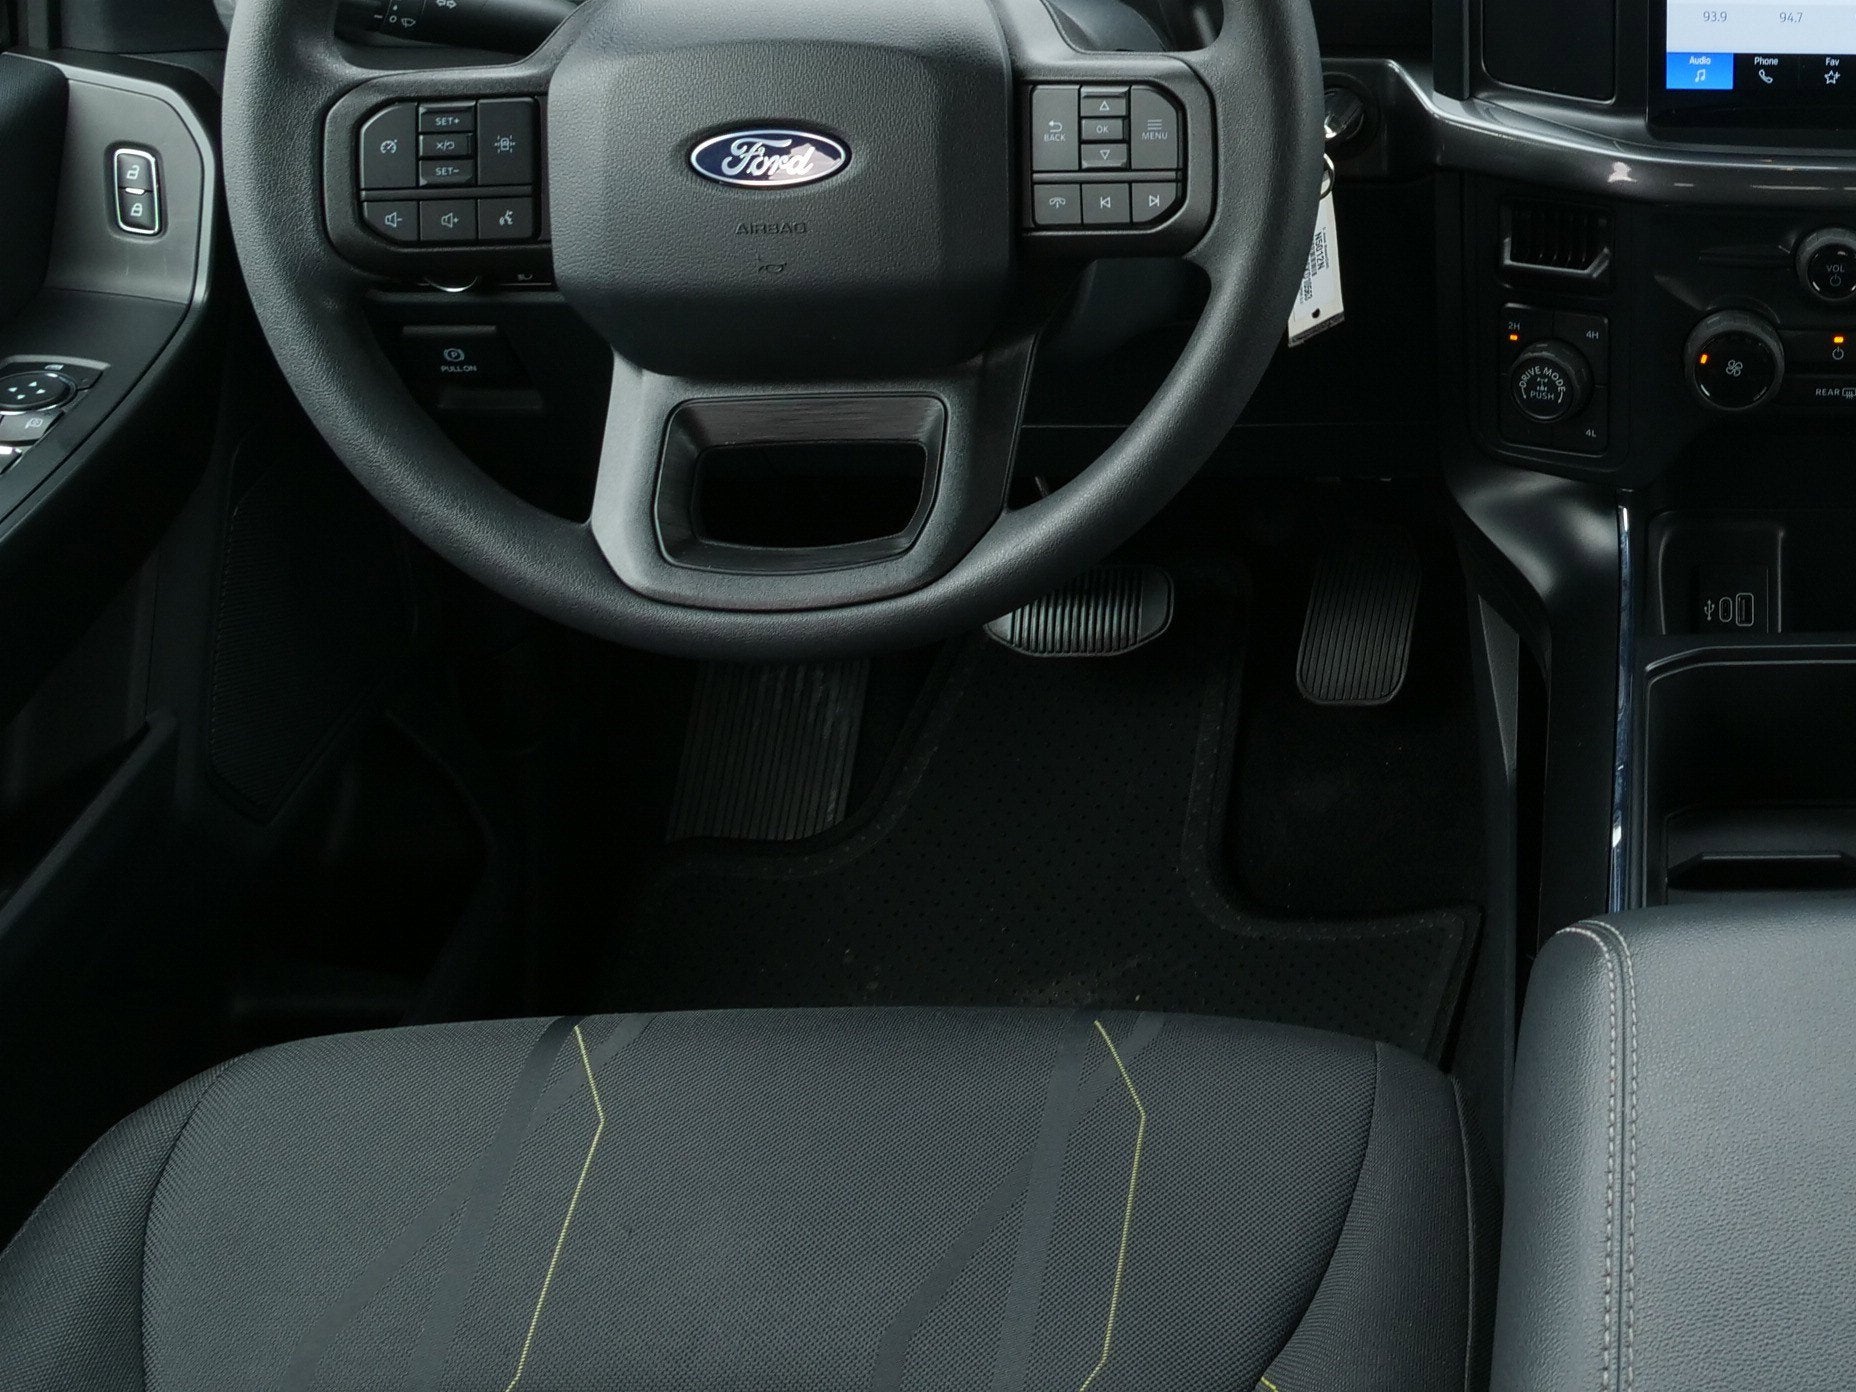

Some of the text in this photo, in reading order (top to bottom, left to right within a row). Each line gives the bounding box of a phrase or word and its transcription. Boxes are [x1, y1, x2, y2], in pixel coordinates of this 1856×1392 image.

[1702, 11, 1728, 23] 93.9
[1778, 12, 1804, 24] 94.7
[1689, 56, 1711, 65] Audio
[1754, 56, 1779, 66] Phone
[1825, 58, 1840, 67] Fav
[1096, 125, 1109, 134] OK
[1044, 133, 1066, 142] BACK
[1141, 131, 1168, 140] MENU
[721, 137, 815, 177] Ford
[735, 222, 808, 236] AIRBAG
[1826, 264, 1845, 273] VOL
[1508, 321, 1521, 331] 2H
[1586, 330, 1600, 340] 4H
[1519, 365, 1566, 393] DRIVE MODE
[1529, 390, 1555, 401] PUSH
[1815, 388, 1841, 397] REAR
[1585, 428, 1597, 439] 4L
